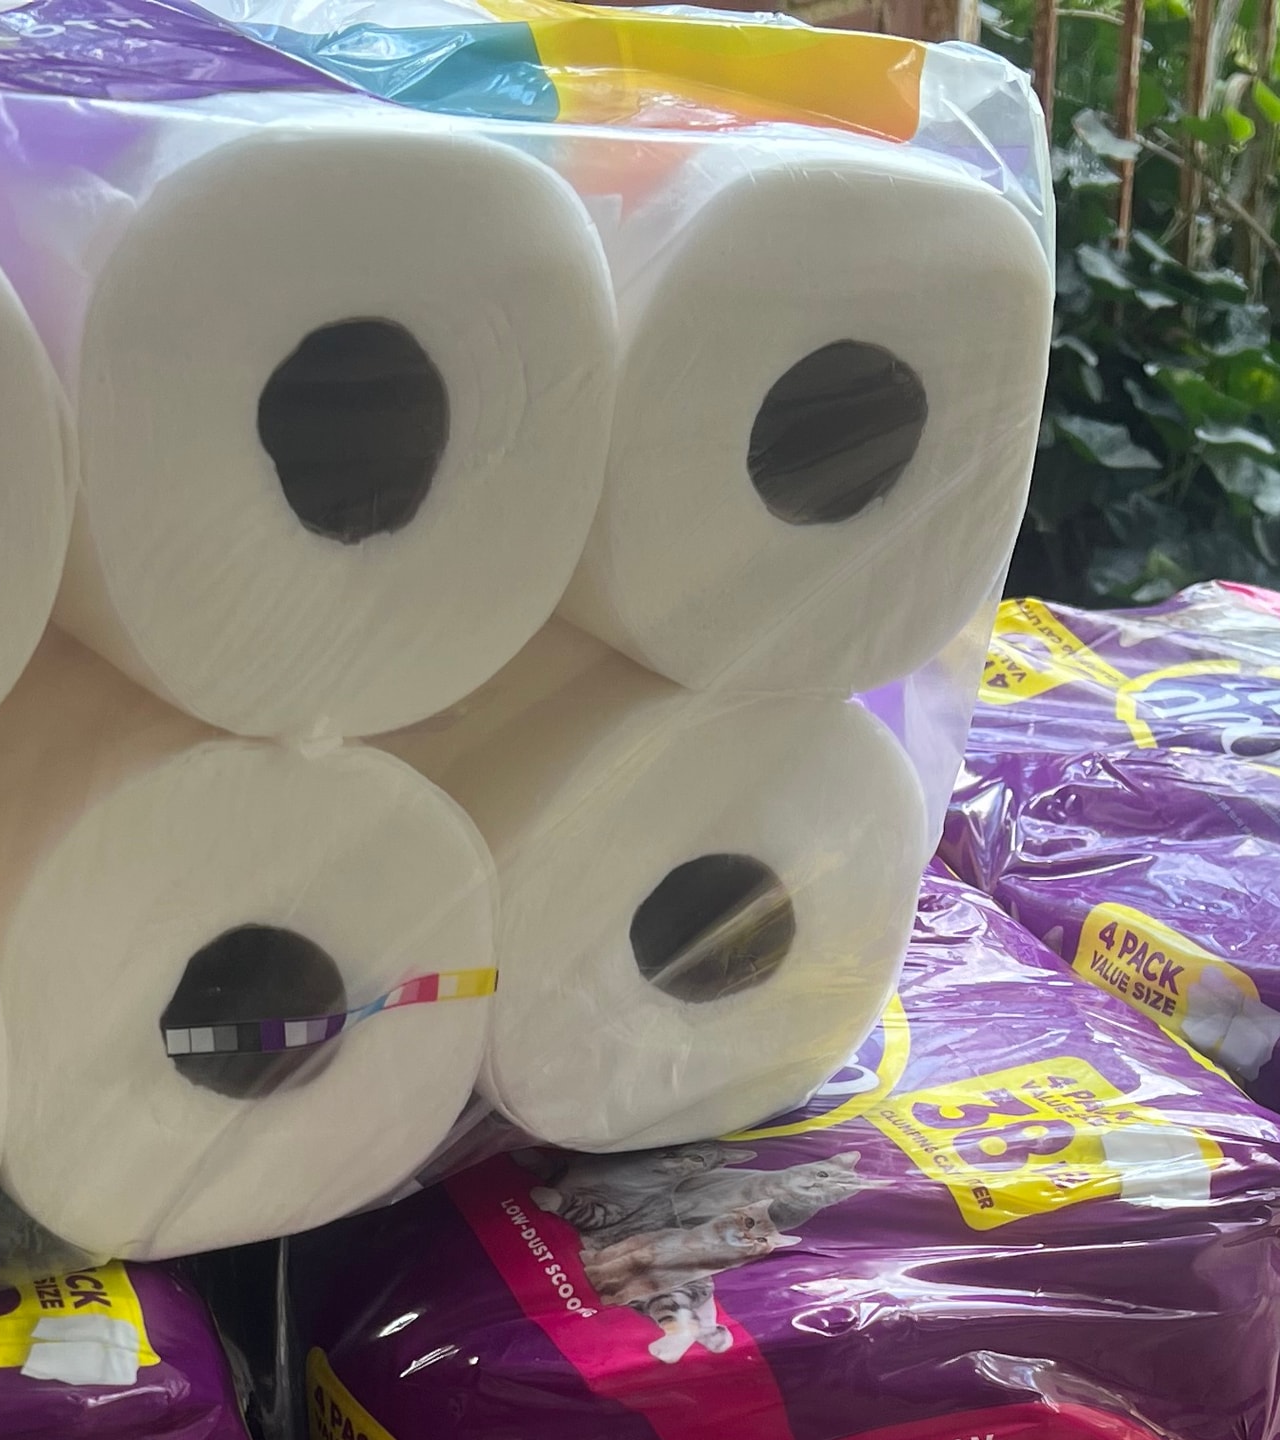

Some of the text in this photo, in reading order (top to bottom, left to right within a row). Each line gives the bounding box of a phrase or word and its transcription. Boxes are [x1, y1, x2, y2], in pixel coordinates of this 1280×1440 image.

[1089, 949, 1178, 1018] VALUE SIZE
[1098, 921, 1185, 997] 4 PACK
[910, 1087, 1077, 1173] 38
[500, 1197, 555, 1264] LOW-DUST
[63, 1266, 112, 1310] CK
